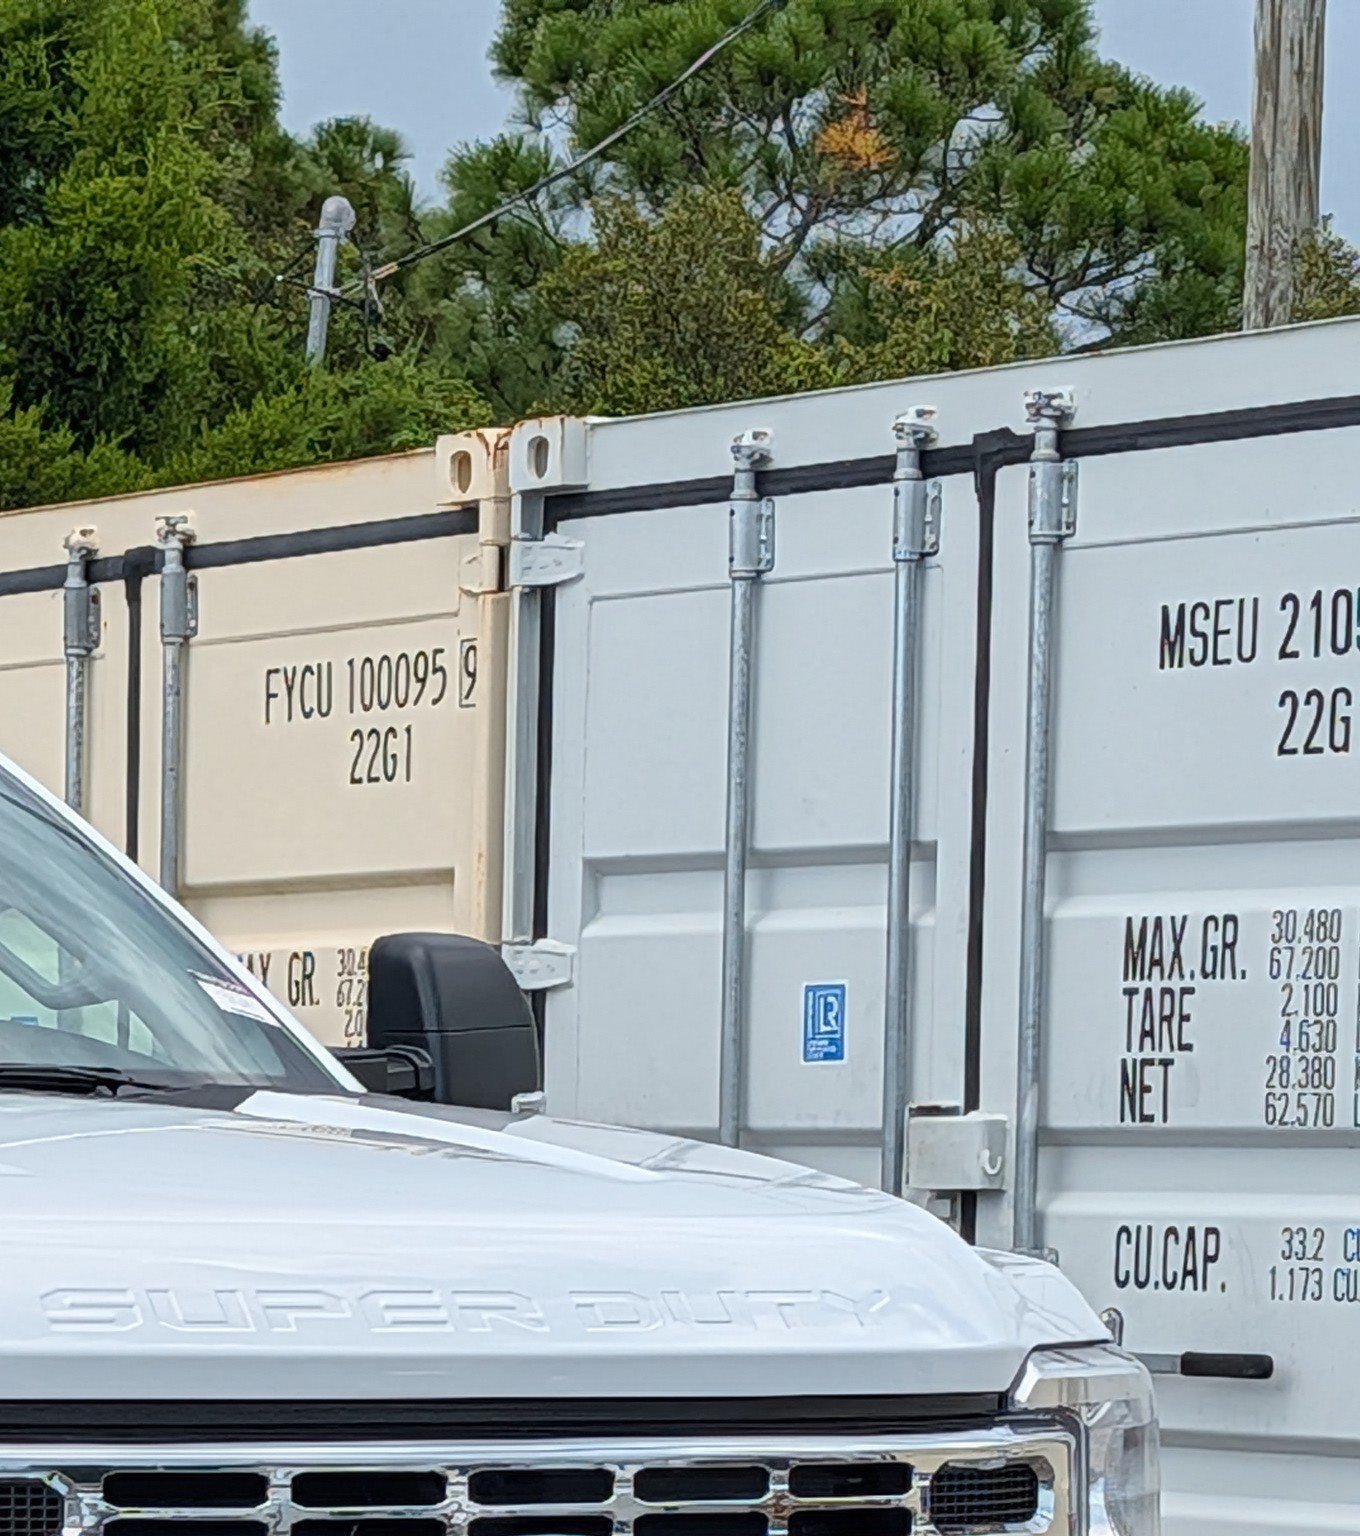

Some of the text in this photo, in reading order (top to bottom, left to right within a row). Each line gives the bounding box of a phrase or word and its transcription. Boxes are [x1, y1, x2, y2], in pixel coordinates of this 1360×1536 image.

[1158, 587, 1360, 670] MSEU 210
[264, 642, 477, 725] FYCU 100095 9
[1276, 686, 1353, 757] 22G
[349, 724, 413, 785] 22G1
[1270, 908, 1342, 945] 30.480
[288, 950, 320, 1007] GR.
[1269, 946, 1340, 981] 67.200
[1122, 982, 1338, 1053] TARE 2.100
[1279, 1019, 1337, 1055] 4.630
[1120, 1055, 1336, 1124] NET 28.380
[1264, 1092, 1335, 1127] 62.570
[1280, 1226, 1326, 1262] 33.2
[1268, 1265, 1324, 1302] 1.173
[39, 1287, 891, 1332] SUPER DUTY
